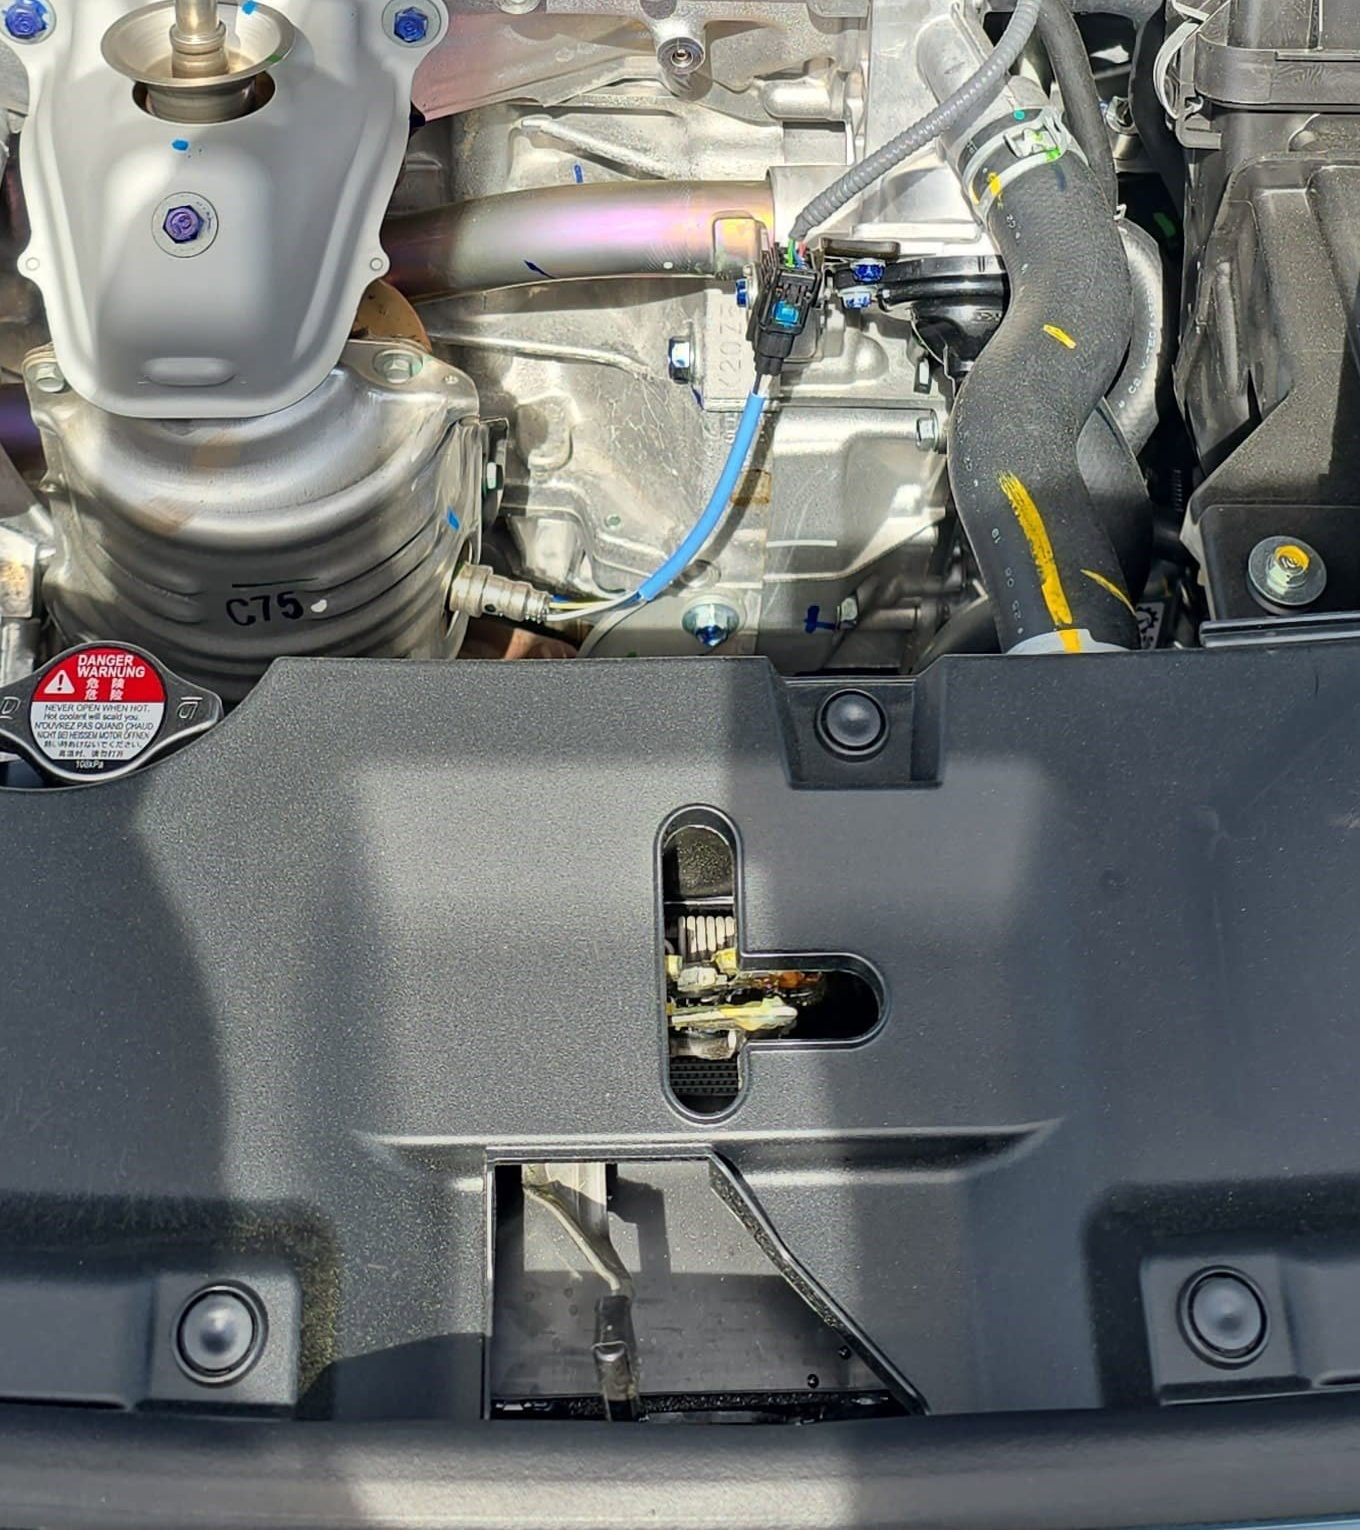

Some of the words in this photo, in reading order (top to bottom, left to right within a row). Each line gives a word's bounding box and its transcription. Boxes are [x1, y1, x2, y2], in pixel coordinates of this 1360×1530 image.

[225, 590, 304, 626] C75
[78, 655, 134, 666] DANGER
[77, 667, 145, 678] WARNUNG
[45, 704, 74, 712] NEVER
[76, 704, 101, 712] OPEN
[102, 704, 129, 712] WHEN
[44, 712, 58, 720] Hot
[77, 722, 95, 730] PAS
[96, 722, 124, 730] QUAND
